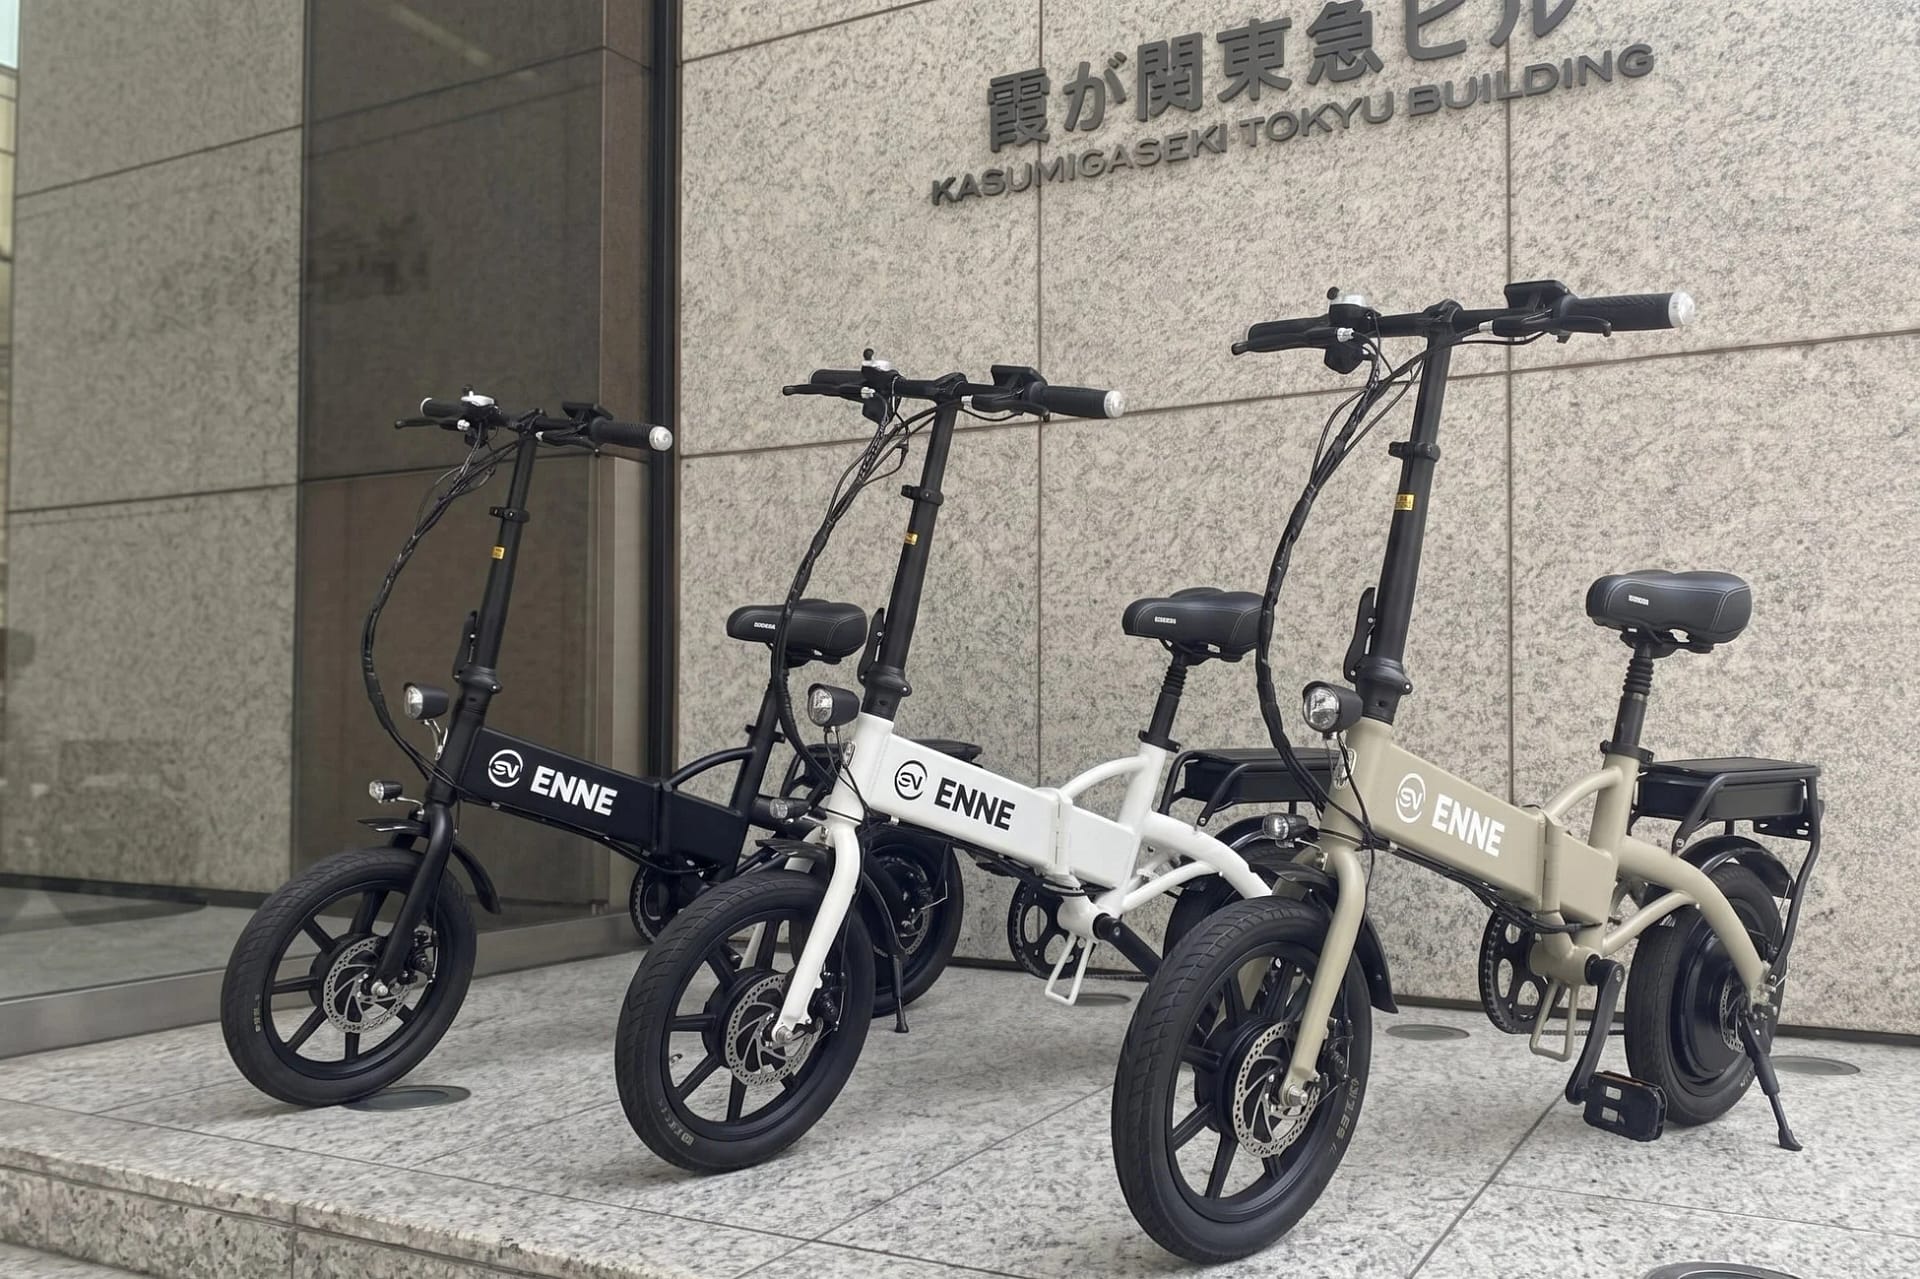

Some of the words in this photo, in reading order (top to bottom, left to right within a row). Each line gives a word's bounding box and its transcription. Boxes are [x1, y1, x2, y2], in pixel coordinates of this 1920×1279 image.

[932, 123, 1228, 206] KASUMIGASEKI
[1239, 91, 1394, 147] TOKYU
[1408, 43, 1655, 117] BUILDING
[530, 765, 618, 816] ENNE
[934, 777, 1016, 831] ENNE
[1431, 793, 1505, 857] ENNE
